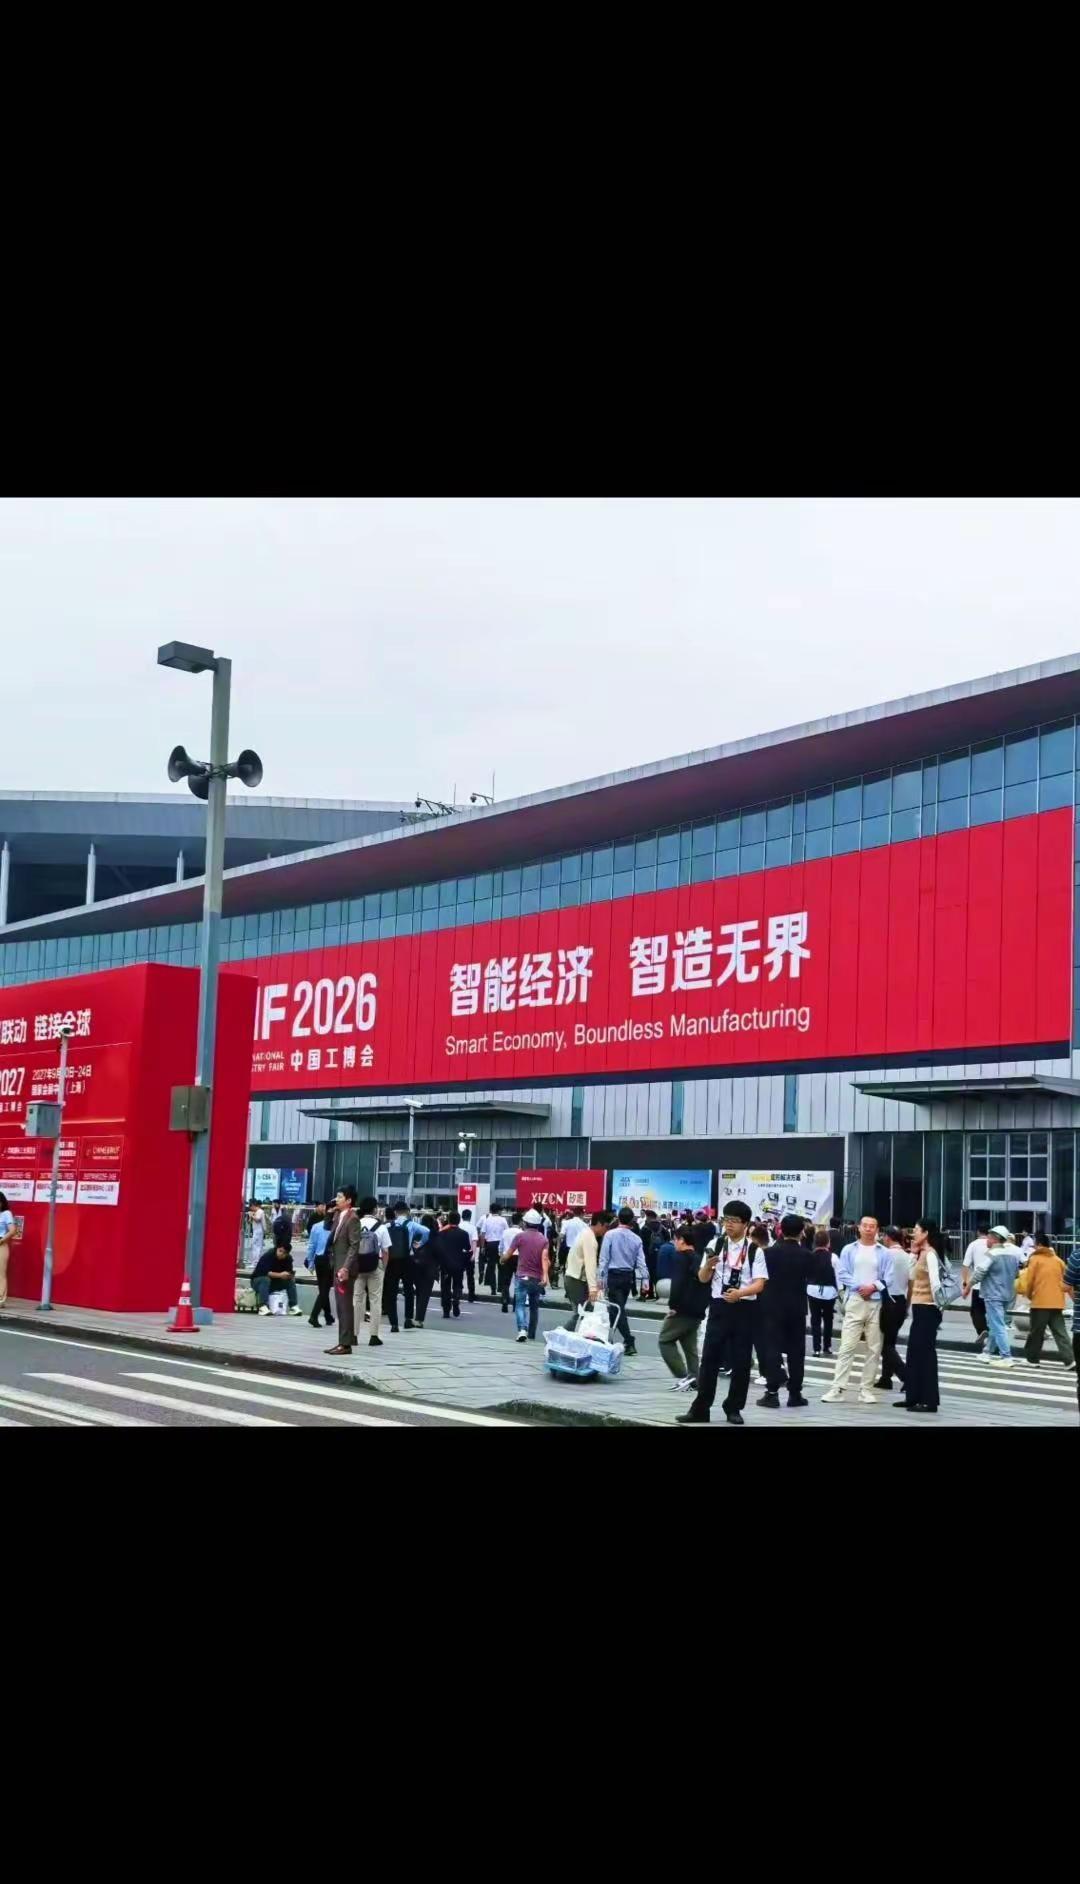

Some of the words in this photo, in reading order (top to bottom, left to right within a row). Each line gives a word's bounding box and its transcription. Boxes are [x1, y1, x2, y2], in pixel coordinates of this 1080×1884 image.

[449, 945, 594, 1017] 智能经济
[629, 911, 811, 997] 智造无界
[292, 972, 377, 1038] 2026
[0, 1017, 27, 1045] 联动
[34, 1008, 92, 1041] 链接全球
[445, 1031, 488, 1056] Smart
[493, 1028, 567, 1053] Economy,
[574, 1019, 664, 1043] Boundless
[670, 1003, 811, 1037] Manufacturing
[268, 1062, 285, 1072] FAIR
[290, 1044, 374, 1072] 中国工博会
[0, 1067, 25, 1096] 027
